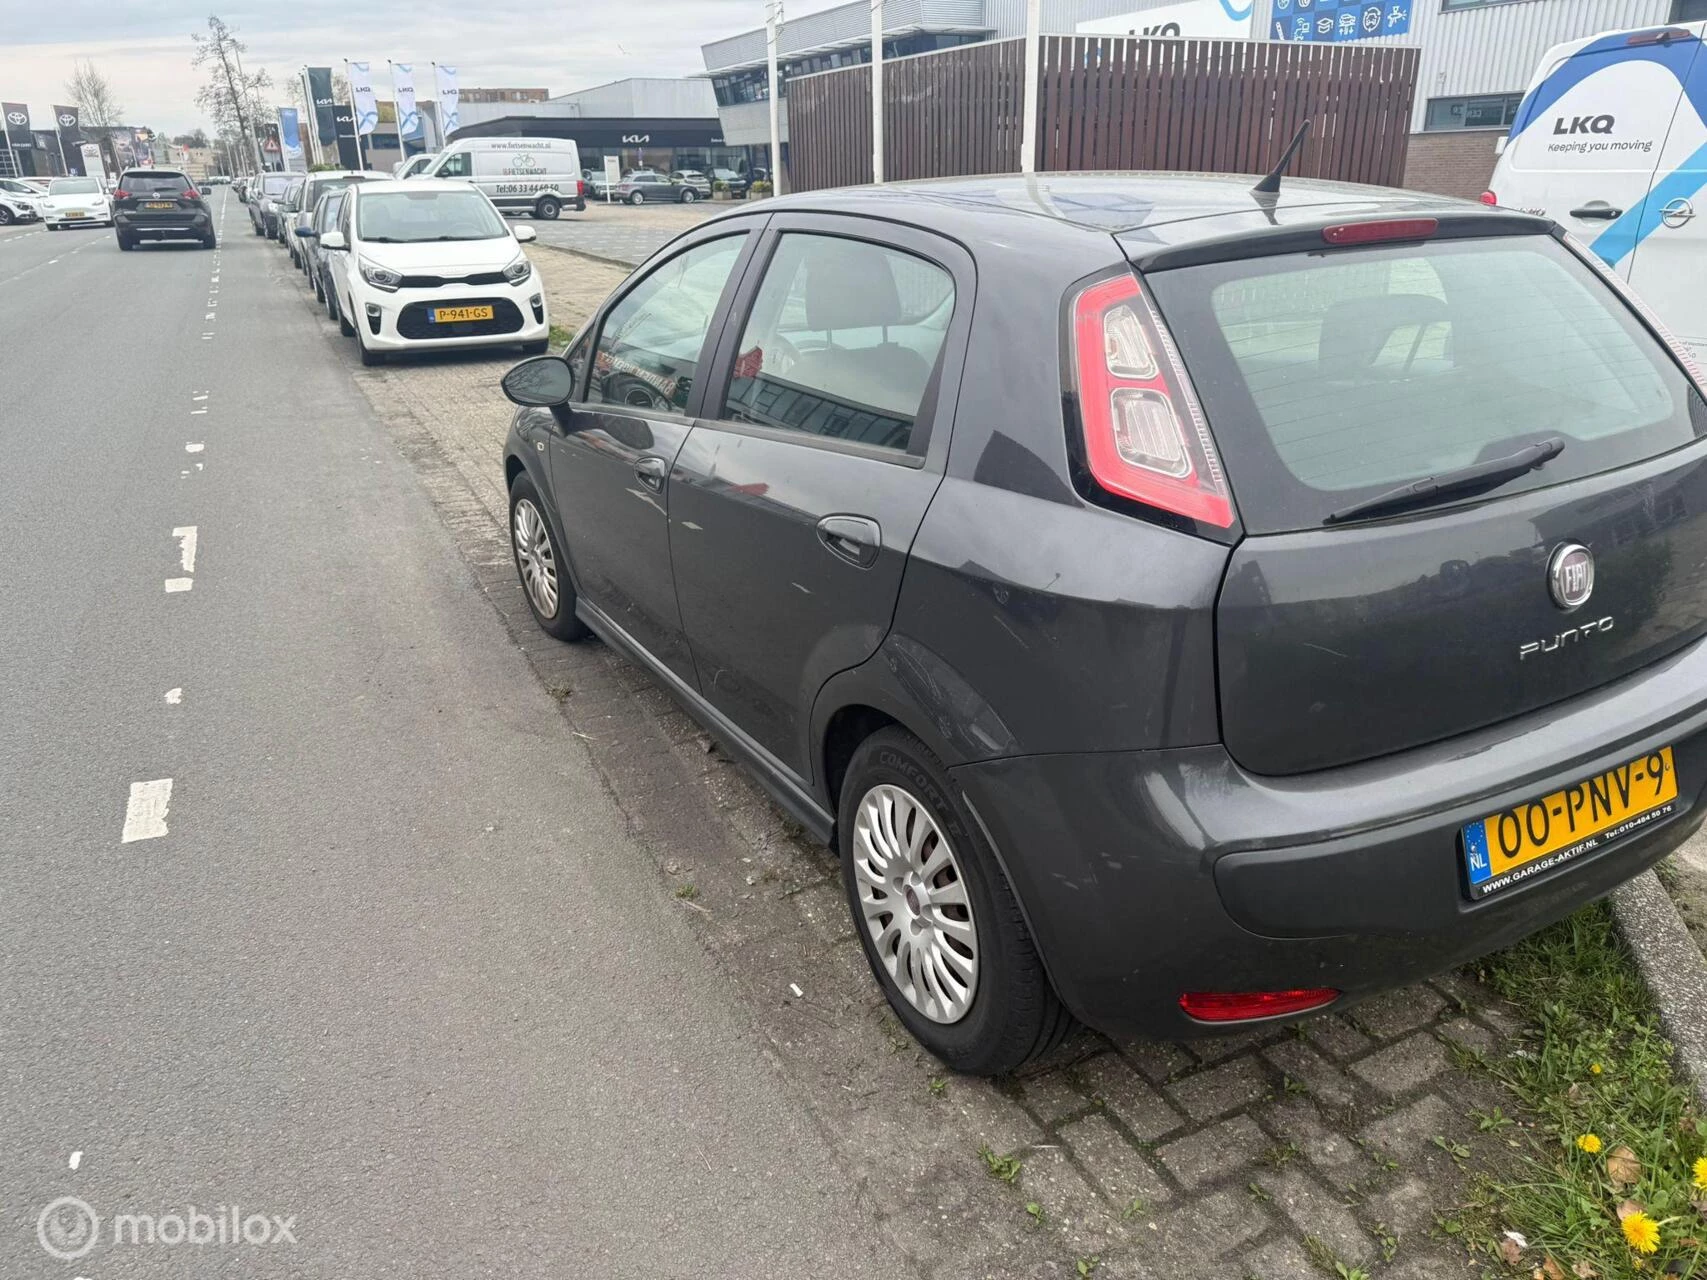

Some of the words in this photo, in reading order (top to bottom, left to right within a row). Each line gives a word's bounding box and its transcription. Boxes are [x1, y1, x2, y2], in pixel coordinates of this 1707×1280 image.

[1553, 114, 1615, 135] LKQ
[622, 134, 650, 143] KIA
[1548, 141, 1587, 153] Keeping
[1588, 144, 1608, 153] you
[1610, 140, 1653, 152] moving
[439, 307, 488, 319] P-941-GS
[1564, 560, 1587, 594] FIAT
[1519, 616, 1614, 660] PUNTO
[879, 751, 948, 809] COMFORT
[1497, 751, 1665, 858] 00-PNV-9
[1470, 853, 1488, 872] NL
[1482, 839, 1599, 893] WWW.GARAGE-AKTIF.NL
